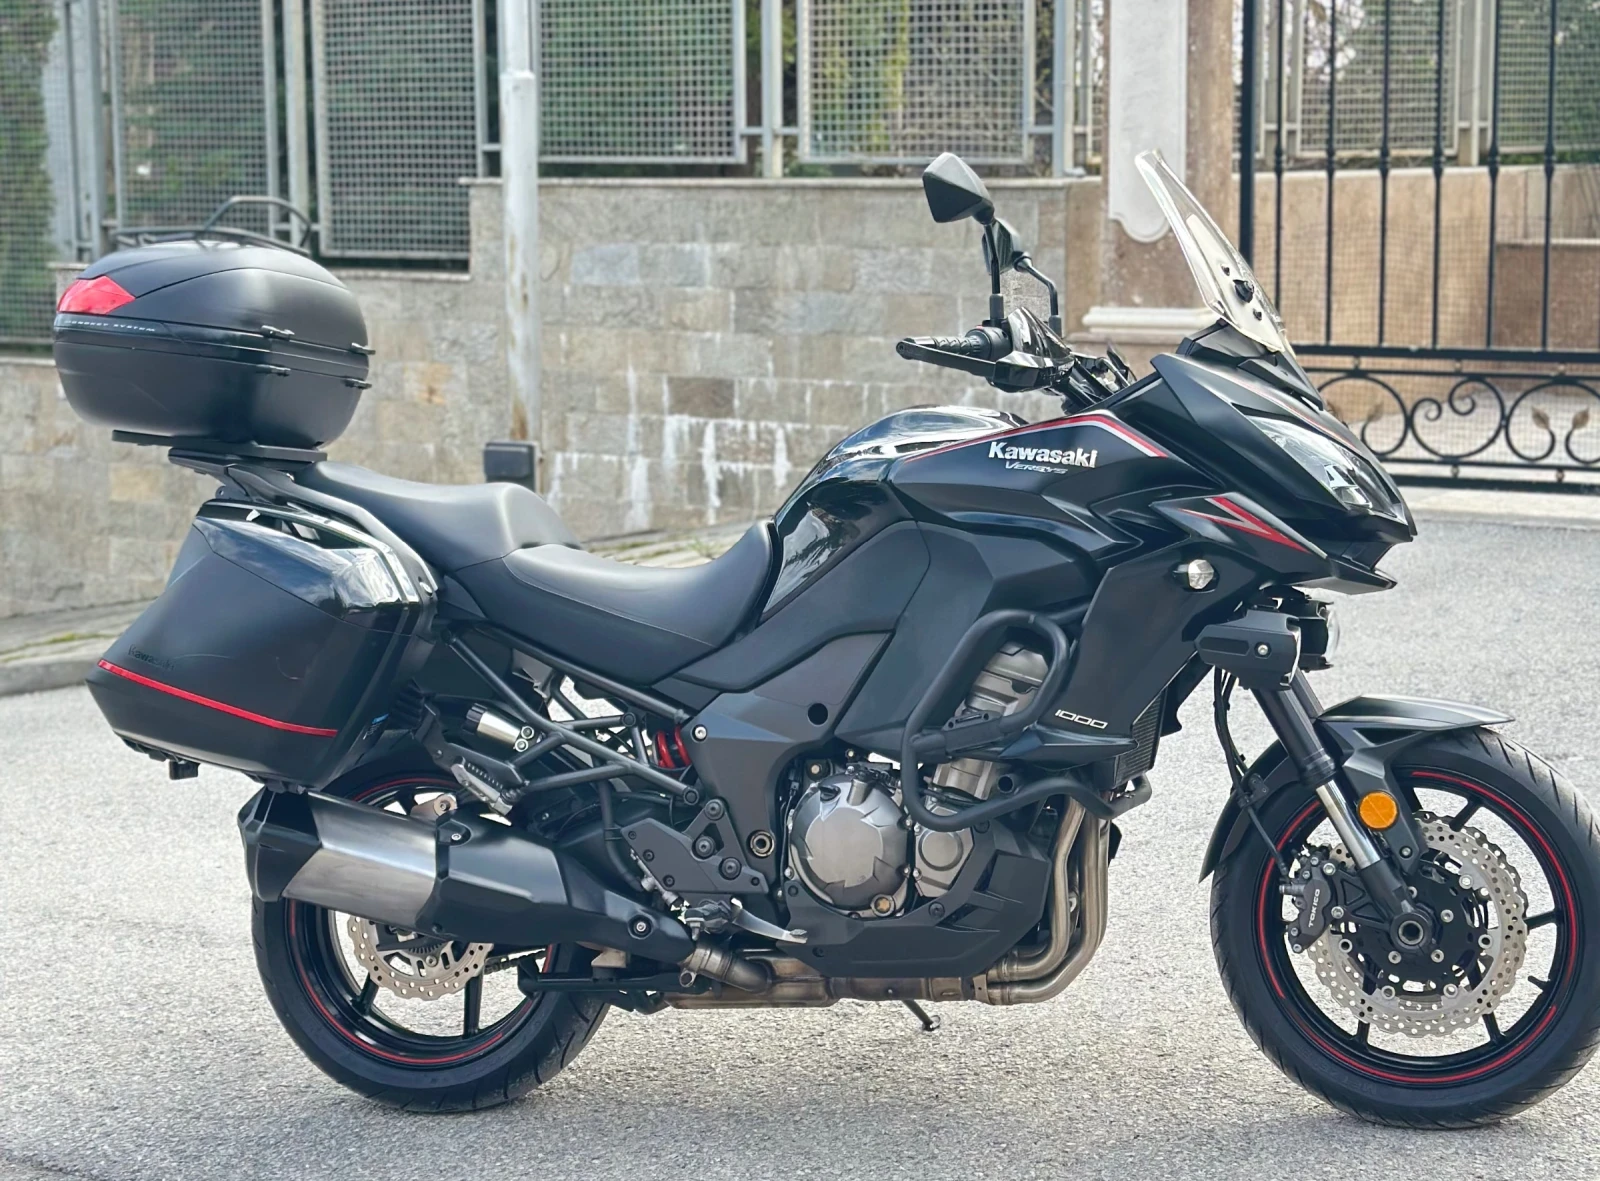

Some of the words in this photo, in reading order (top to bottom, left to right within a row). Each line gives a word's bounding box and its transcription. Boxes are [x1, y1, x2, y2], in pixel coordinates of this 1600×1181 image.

[988, 441, 1098, 468] Kawasaki
[1055, 709, 1108, 729] 1000
[1308, 889, 1320, 928] TOKICO
